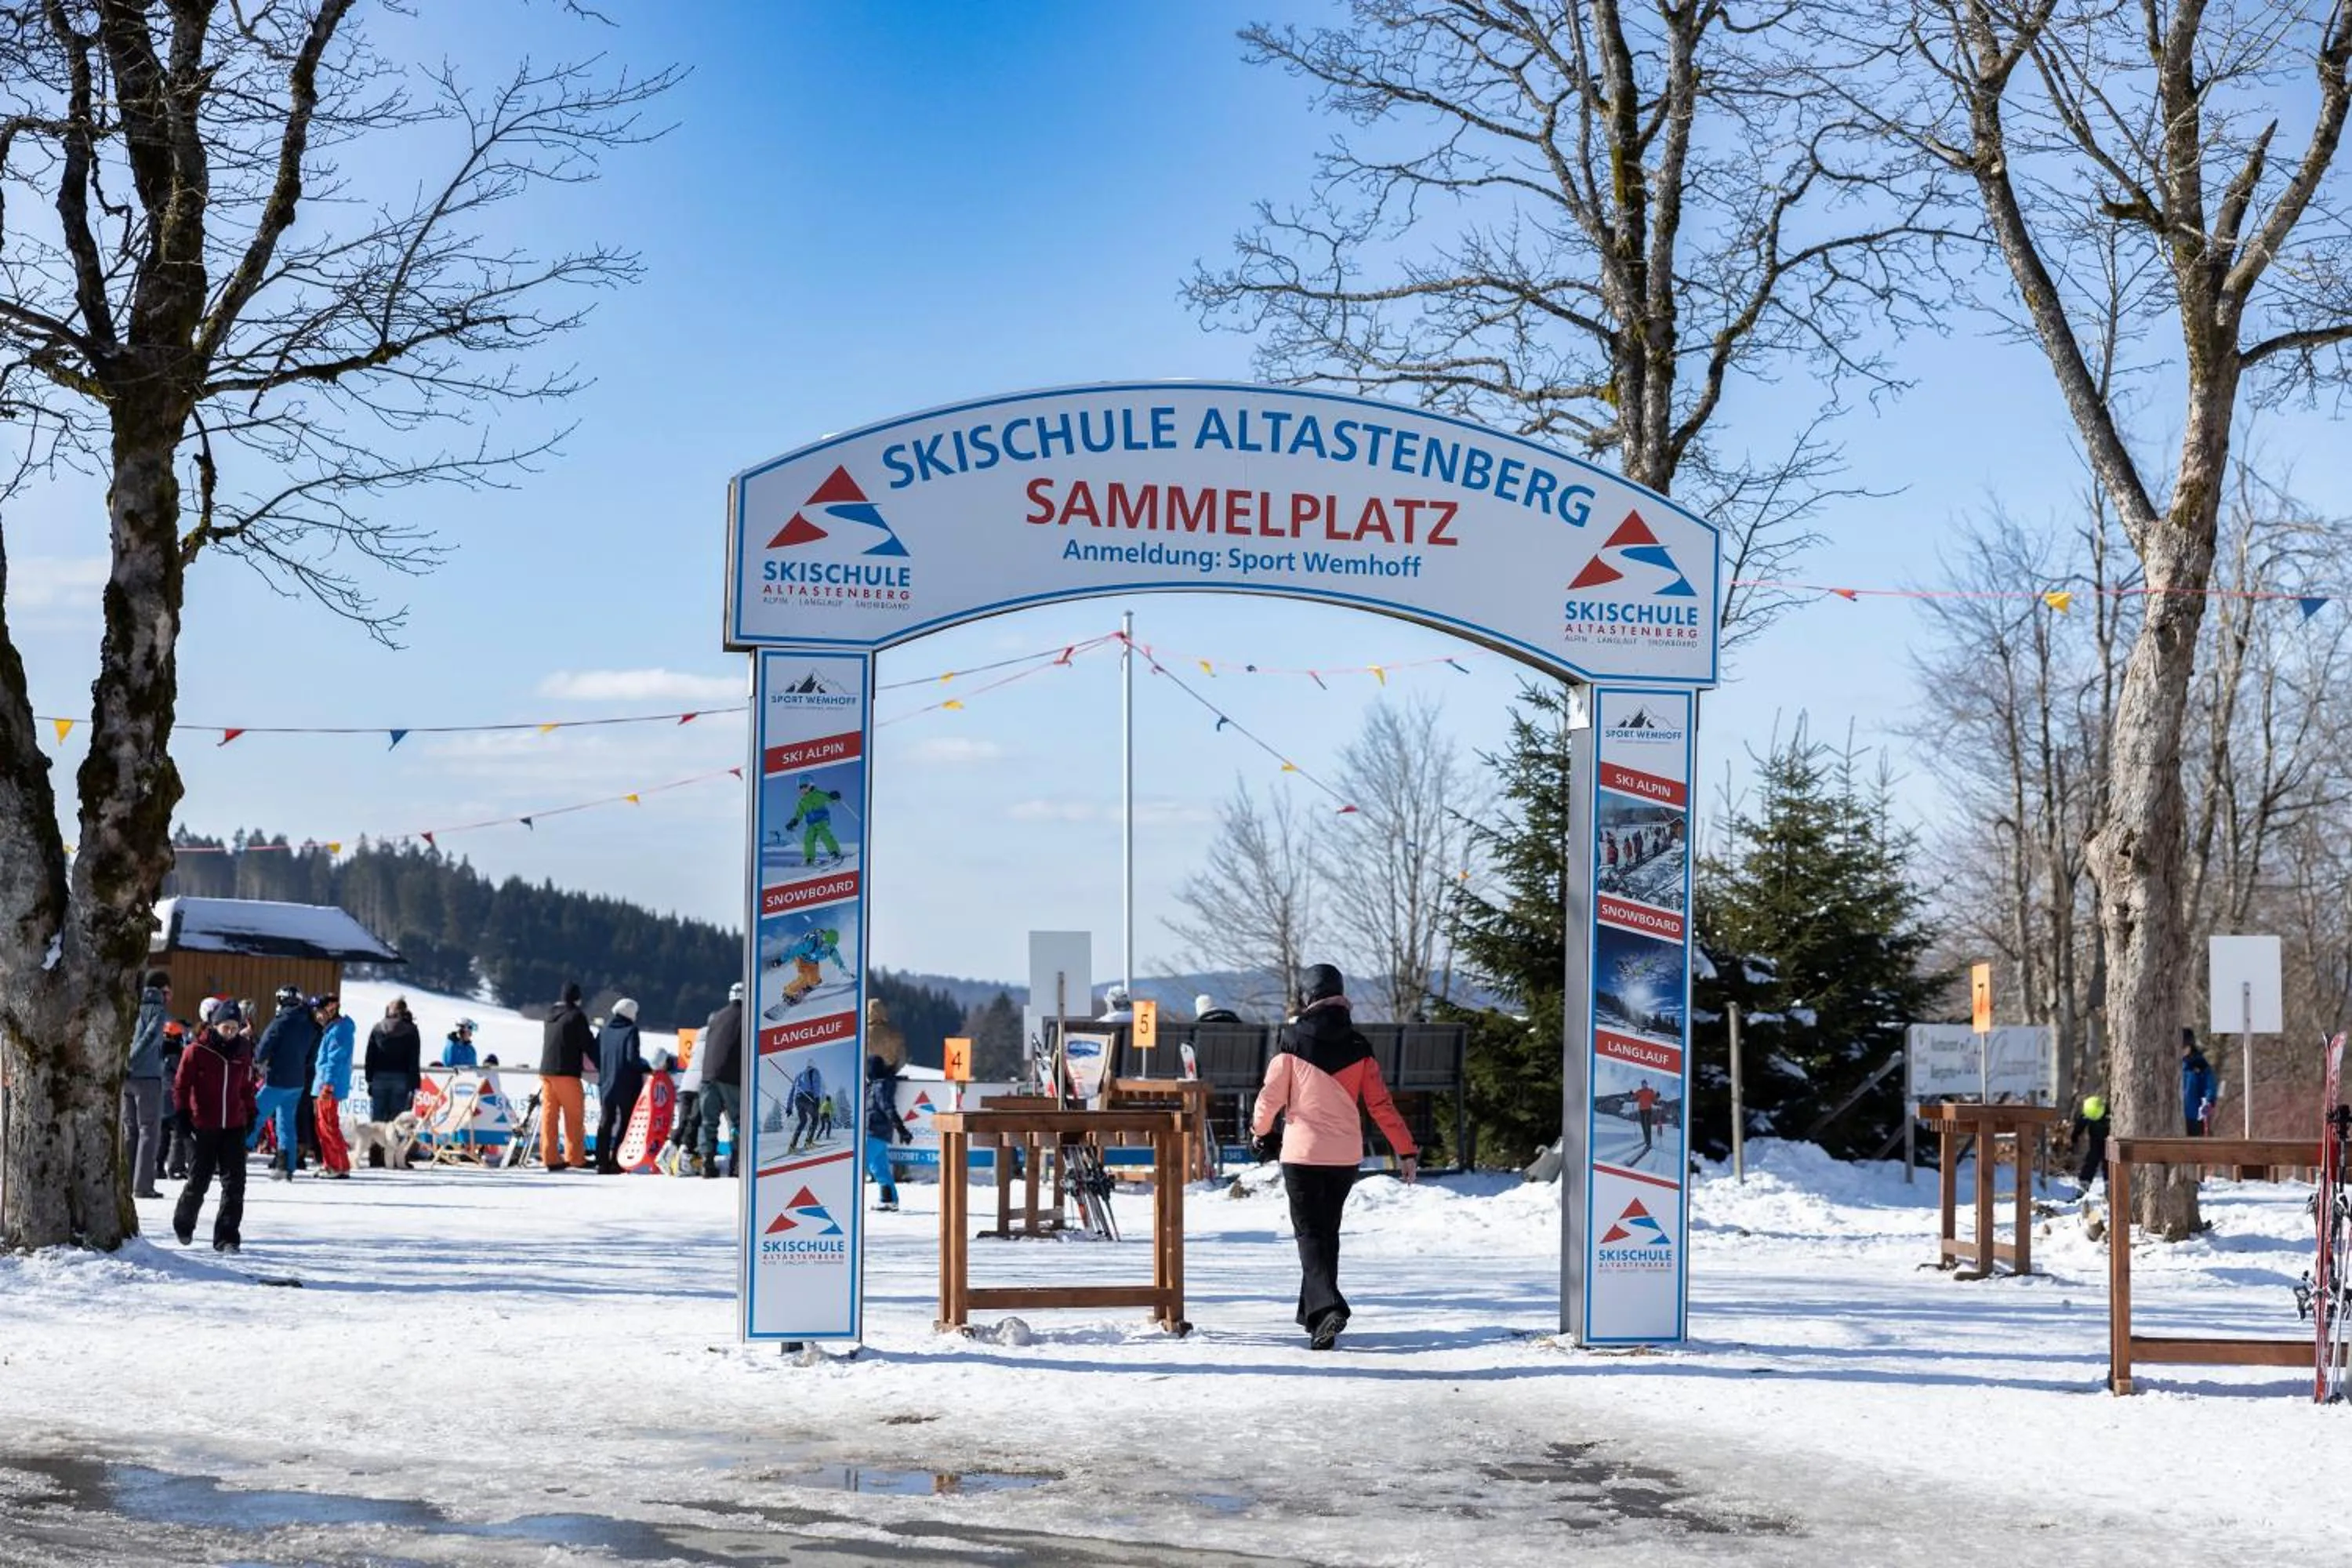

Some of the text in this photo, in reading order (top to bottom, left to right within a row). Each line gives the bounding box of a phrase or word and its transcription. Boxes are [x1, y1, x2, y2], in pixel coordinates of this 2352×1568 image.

[883, 407, 1595, 528] SKISCHULE ALTASTENBERG
[1026, 477, 1458, 546] SAMMELPLATZ
[1063, 539, 1422, 578] Anmeldung: Sport Wemhoff
[764, 560, 911, 587] SKISCHULE
[763, 584, 910, 601] ALTASTENBERG
[1565, 601, 1698, 626] SKISCHULE
[1565, 623, 1698, 639] ALTASTENBERG
[771, 695, 857, 705] SPORT WEMHOFF
[1605, 729, 1682, 740] SPORT WEMHOFF
[782, 742, 845, 764] SKI ALPIN
[1615, 772, 1671, 797] SKI ALPIN
[766, 879, 855, 908] SNOWBOARD
[1601, 903, 1680, 933] SNOWBOARD
[773, 1021, 843, 1046] LANGLAUF
[1139, 1014, 1149, 1034] 5
[951, 1051, 963, 1069] 4
[1607, 1040, 1670, 1065] LANGLAUF
[762, 1240, 844, 1252] SKISCHULE
[1599, 1249, 1672, 1261] SKISCHULE
